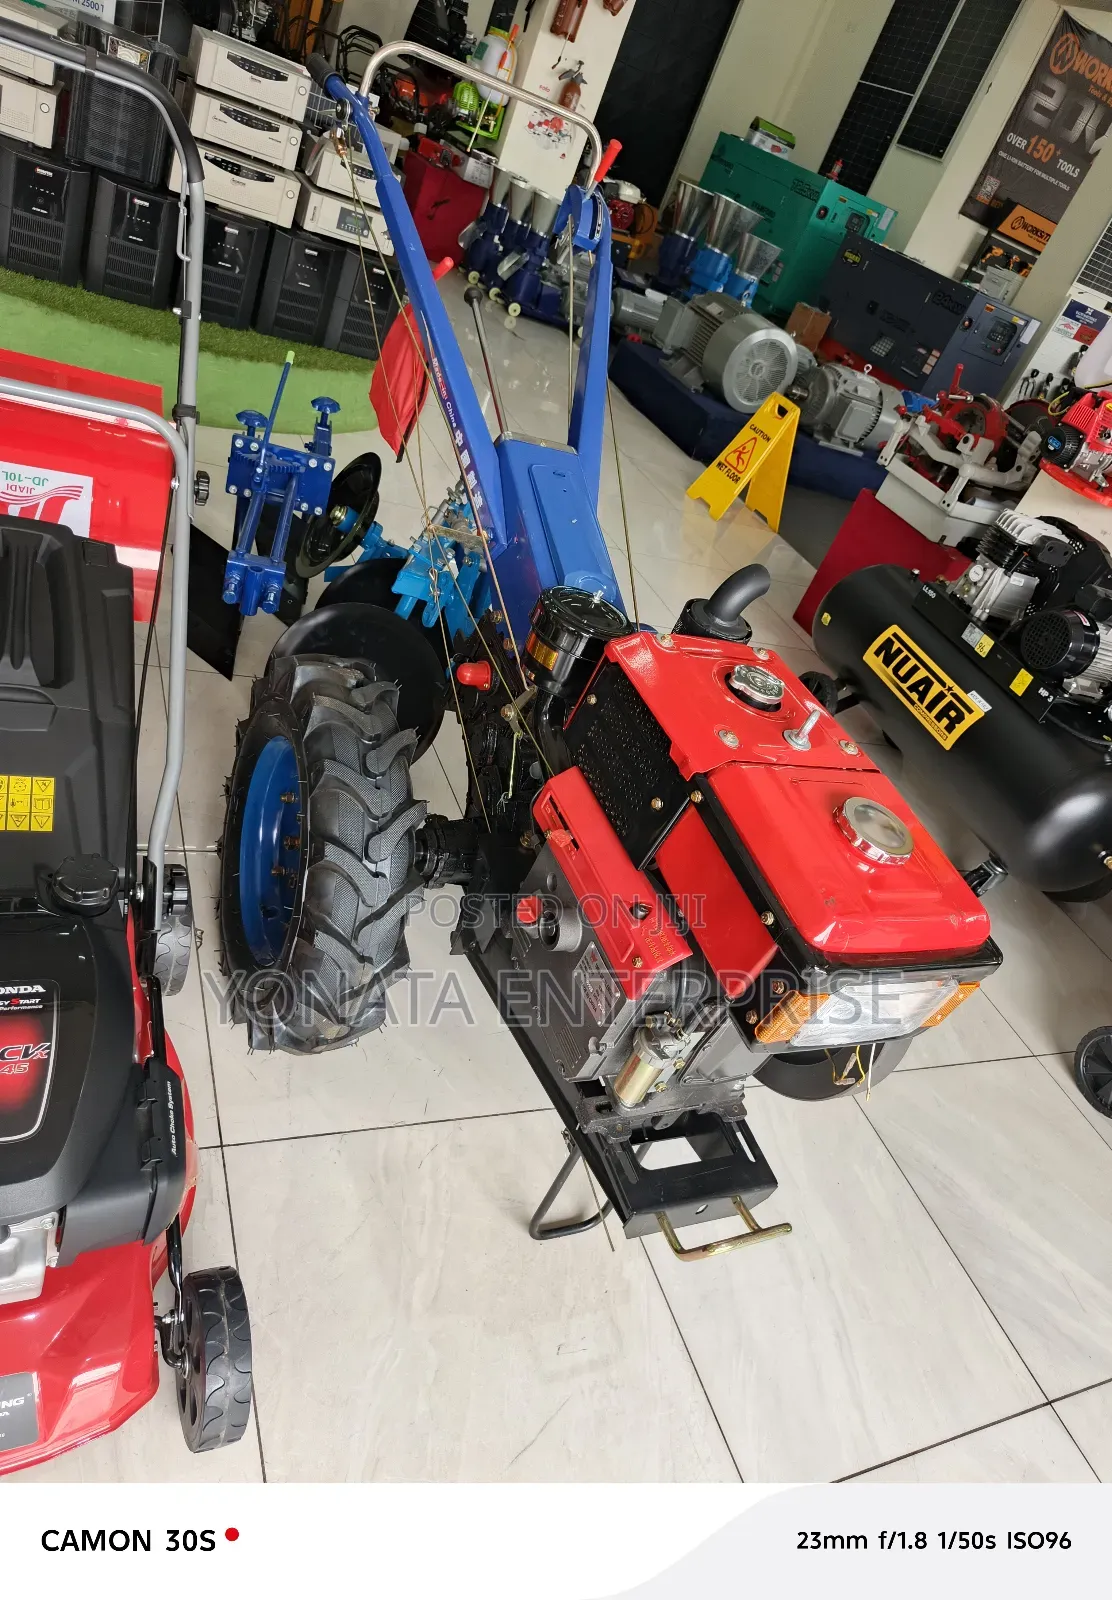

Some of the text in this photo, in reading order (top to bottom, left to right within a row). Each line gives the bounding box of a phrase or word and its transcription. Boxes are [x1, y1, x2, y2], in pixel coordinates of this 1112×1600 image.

[1006, 132, 1028, 150] OVER
[1057, 158, 1080, 178] TOOLS
[750, 424, 772, 443] CAUTION
[716, 461, 741, 484] WET FLOOR
[6, 484, 36, 494] JIADI
[874, 636, 966, 735] NUAIR
[1038, 687, 1054, 703] HP 3
[913, 704, 948, 741] COMPRESSORS
